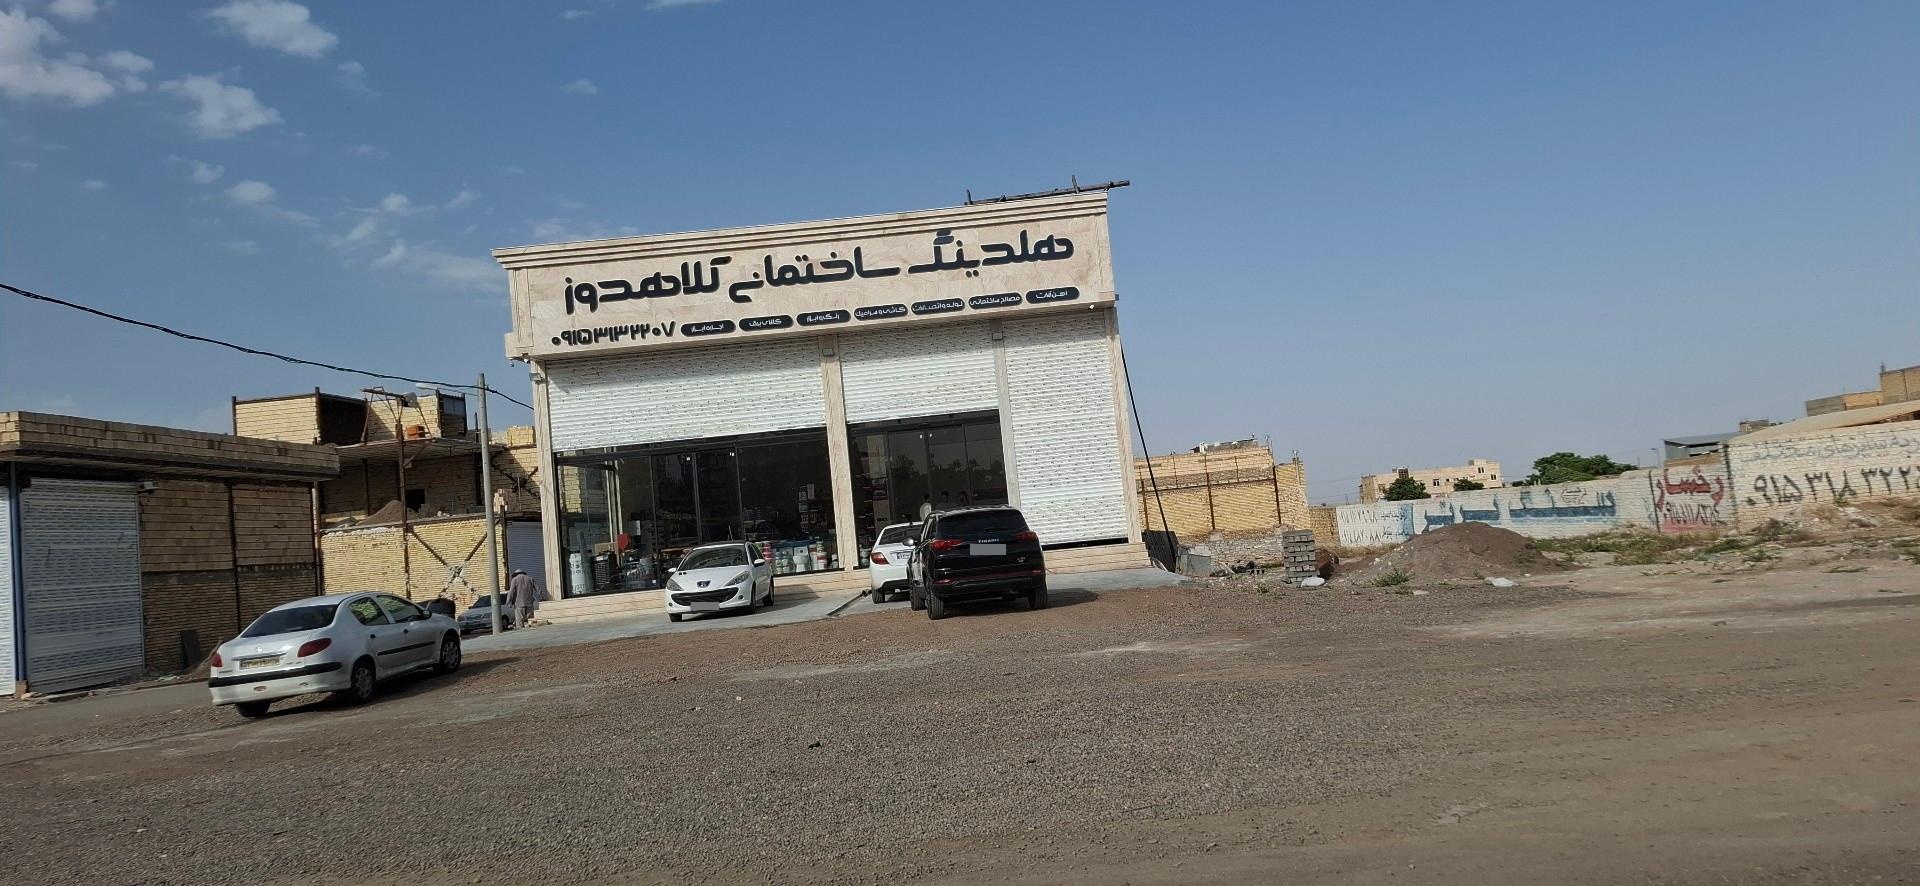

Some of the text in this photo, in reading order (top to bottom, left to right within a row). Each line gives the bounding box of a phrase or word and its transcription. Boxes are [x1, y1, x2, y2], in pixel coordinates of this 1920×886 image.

[564, 227, 1074, 315] هلدینگ ساختمانی کلاهدوز
[946, 300, 963, 309] لوله
[969, 296, 1021, 306] مصالح ساختمانی
[883, 306, 906, 315] کاشی
[551, 320, 676, 346] ۰۹۱۵۳۱۳۲۲۰۷
[1747, 465, 1920, 506] ۰۹۱۵۳۱۸۳۲۲
